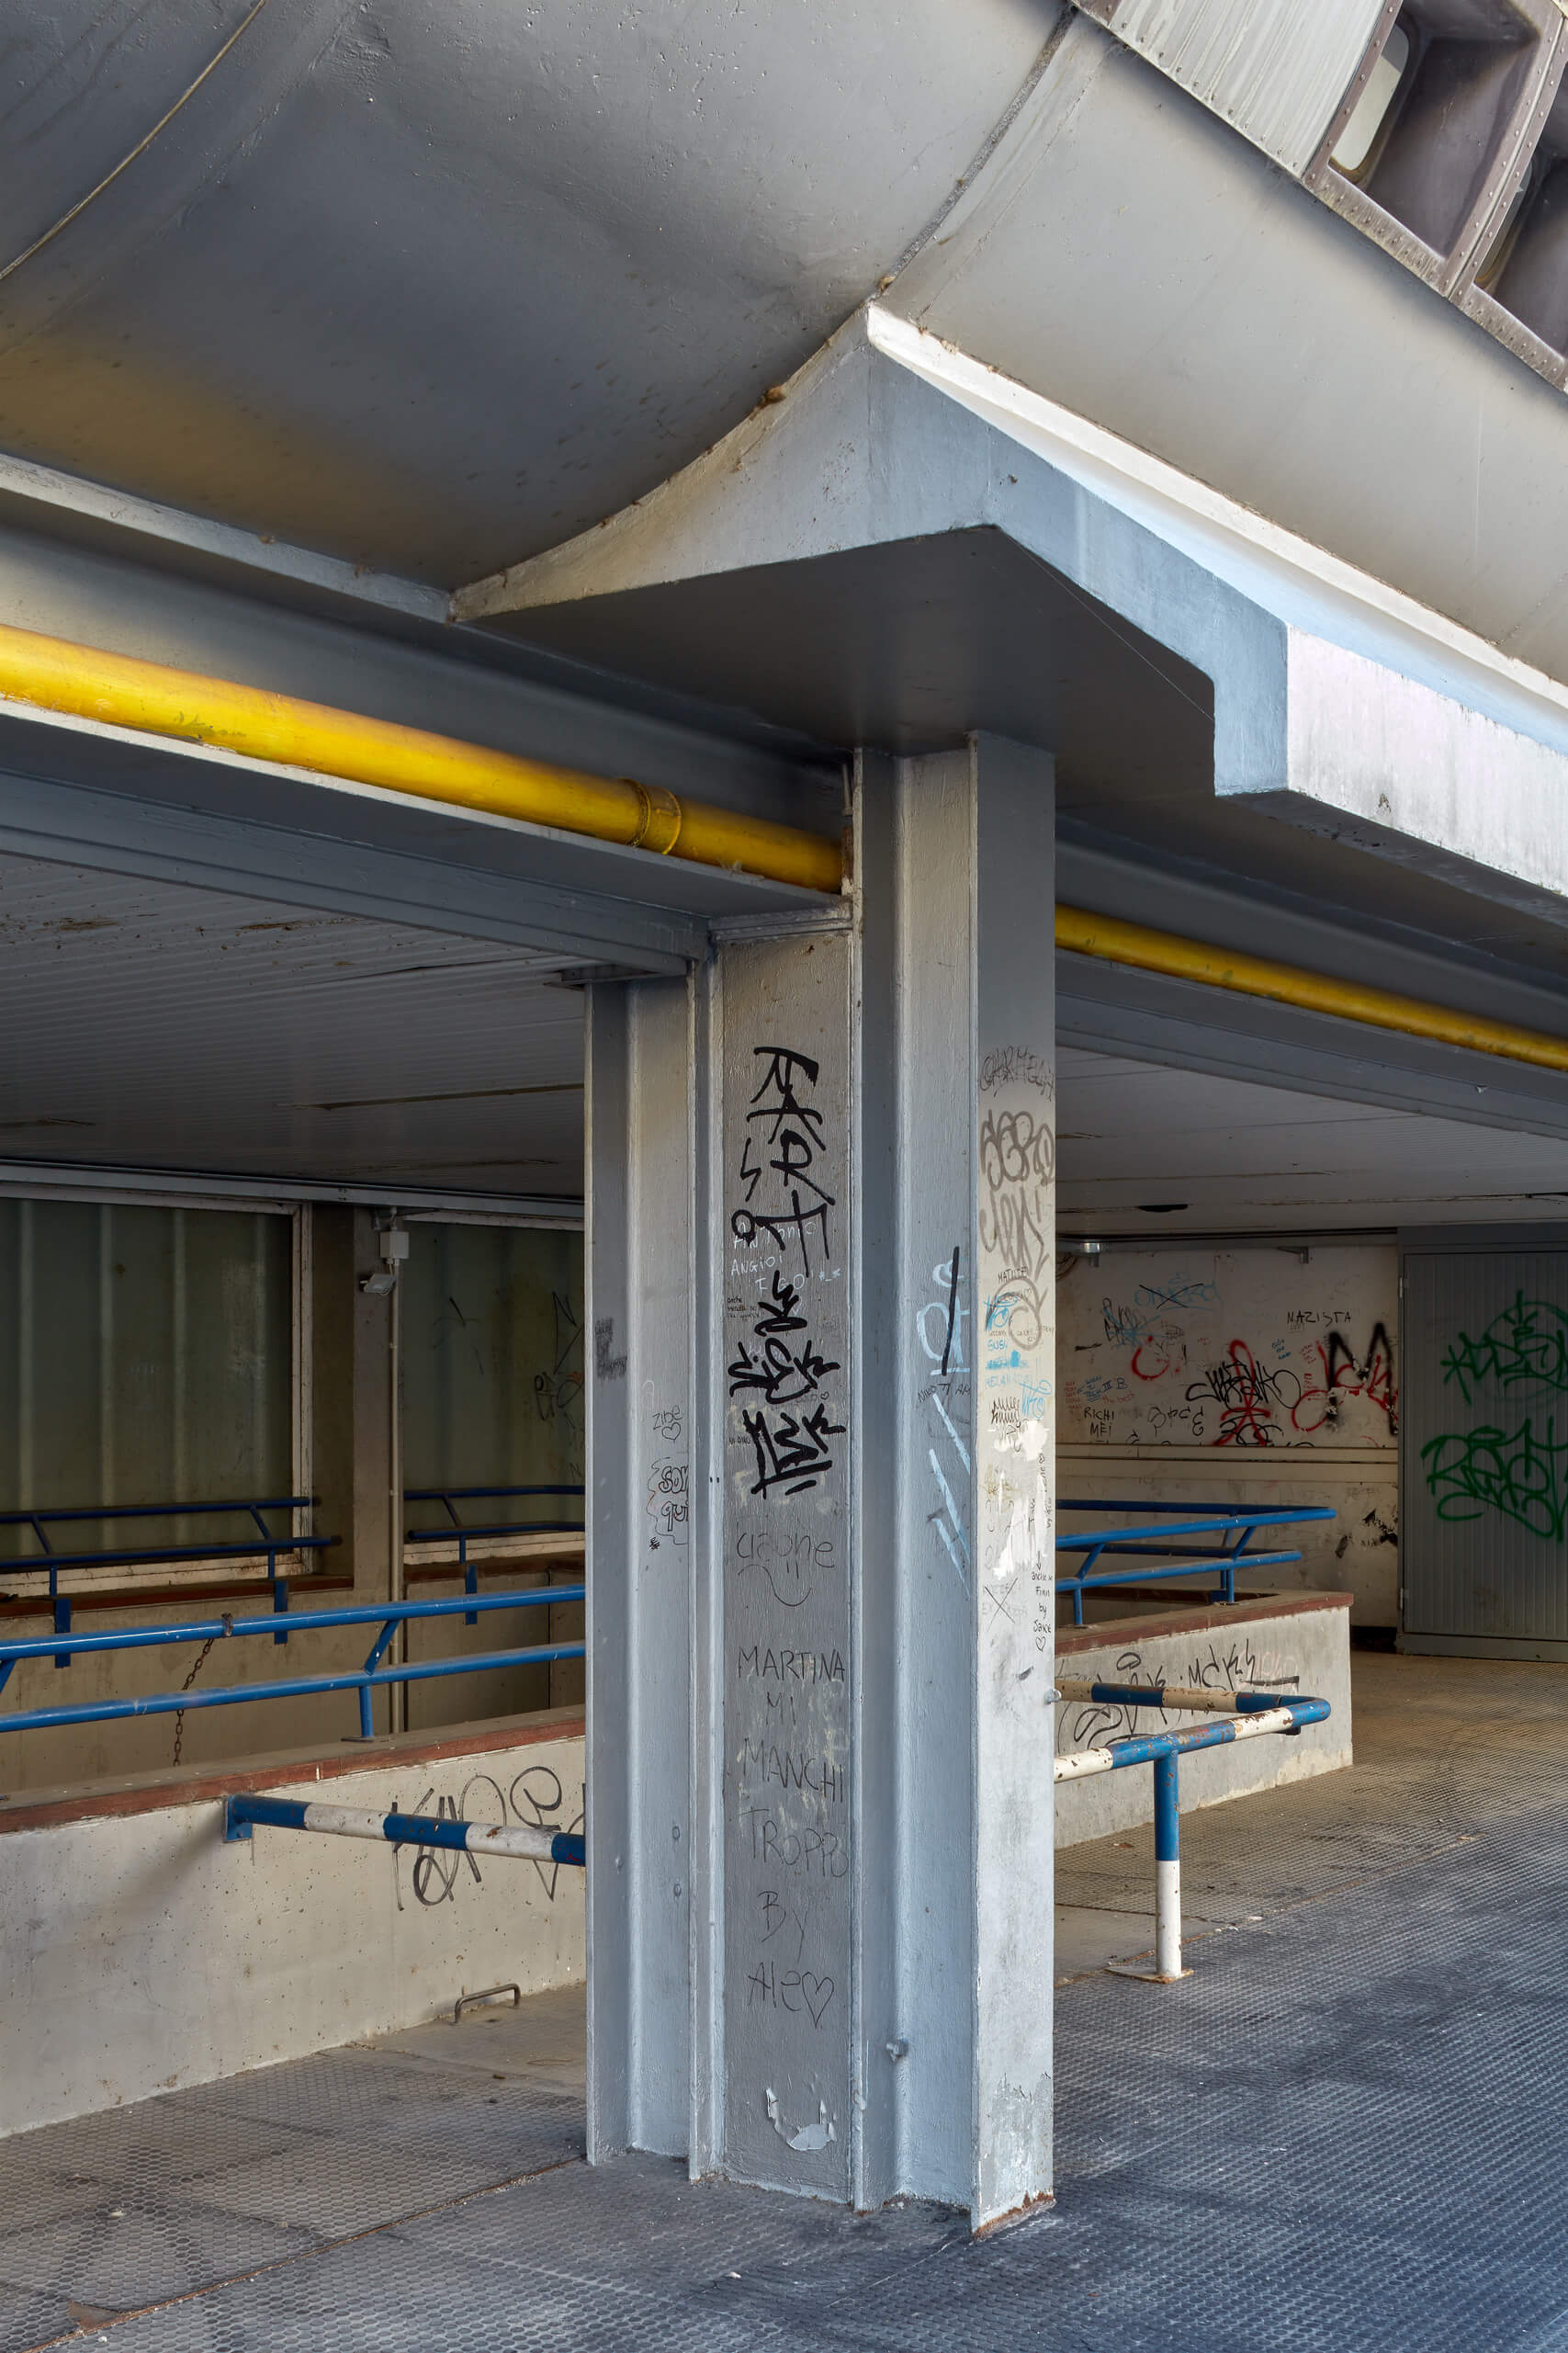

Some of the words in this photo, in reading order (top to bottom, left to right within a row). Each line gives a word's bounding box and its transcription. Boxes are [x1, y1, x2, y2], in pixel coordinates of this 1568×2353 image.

[1287, 1309, 1352, 1328] NAZISTA
[1084, 1406, 1115, 1421] RICHI
[738, 1646, 846, 1685] MARTINA
[765, 1691, 796, 1725] MI
[743, 1737, 844, 1804] MANCHI
[738, 1806, 850, 1878] TROPPO
